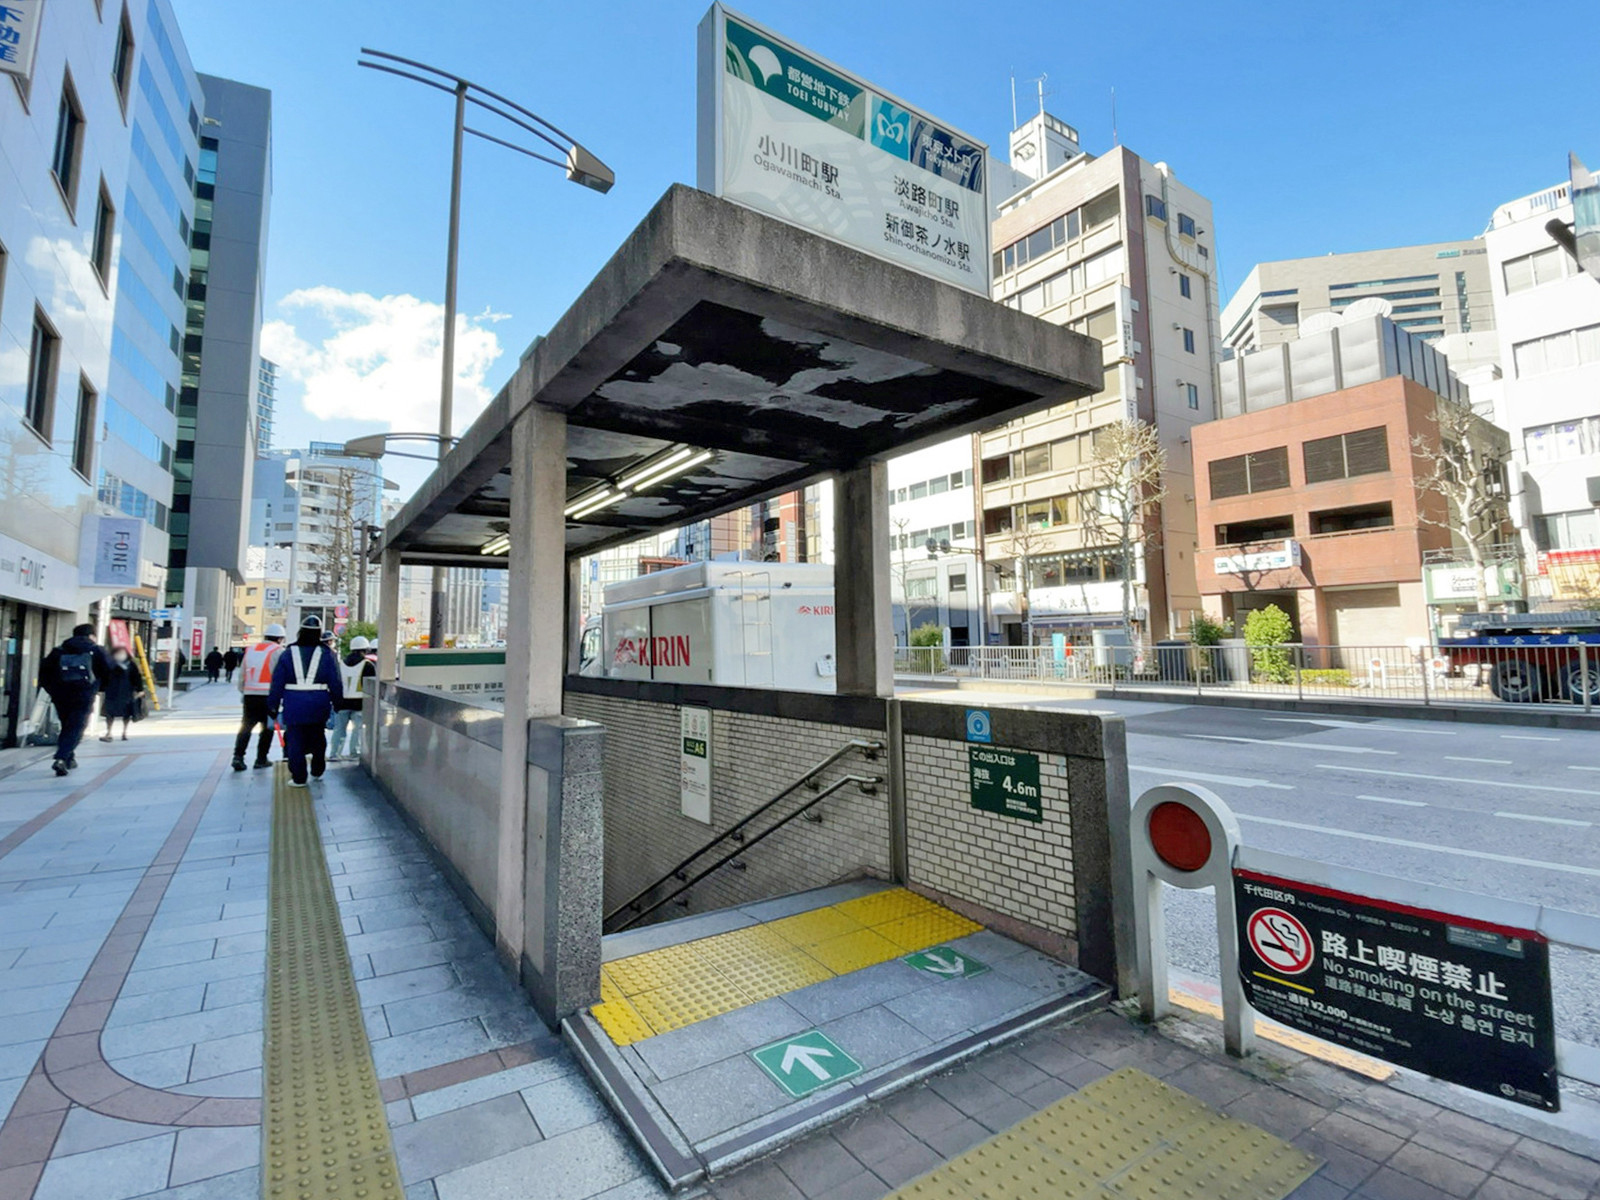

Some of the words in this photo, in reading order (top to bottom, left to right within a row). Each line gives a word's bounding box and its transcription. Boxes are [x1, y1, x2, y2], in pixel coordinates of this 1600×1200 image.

[787, 66, 850, 109] 都営地下鉄
[787, 83, 808, 102] TOEI
[812, 95, 850, 122] SUBWAY
[758, 135, 839, 187] 小川町駅
[921, 133, 971, 168] 東京メトロ
[924, 149, 947, 167] Tokyo
[946, 159, 970, 178] Metro
[754, 154, 822, 191] Ogawamachi
[825, 185, 843, 200] Sta.
[893, 175, 959, 220] 淡路町駅
[900, 199, 938, 222] Awajicho
[940, 215, 956, 229] Sta.
[883, 232, 956, 267] Shin-ochanomizu
[958, 260, 974, 273] Sta.
[886, 213, 970, 261] 新御茶ノ水駅
[813, 606, 834, 616] KIRI
[639, 635, 690, 667] KIRIN
[971, 751, 1016, 766] この出入口は
[1002, 775, 1037, 797] 4.6m
[1243, 883, 1296, 905] 千代田区内
[1321, 929, 1509, 1002] 路上喫煙禁止
[1311, 1000, 1347, 1020] ¥2,000
[1322, 957, 1344, 975] No
[1348, 964, 1415, 998] smoking
[1419, 984, 1442, 1002] on
[1445, 991, 1475, 1013] the
[1479, 1001, 1536, 1030] street
[1324, 975, 1412, 1012] 道路禁止吸烟
[1423, 1003, 1455, 1025] 노상
[1460, 1014, 1494, 1037] 흡연
[1500, 1025, 1534, 1048] 금지
